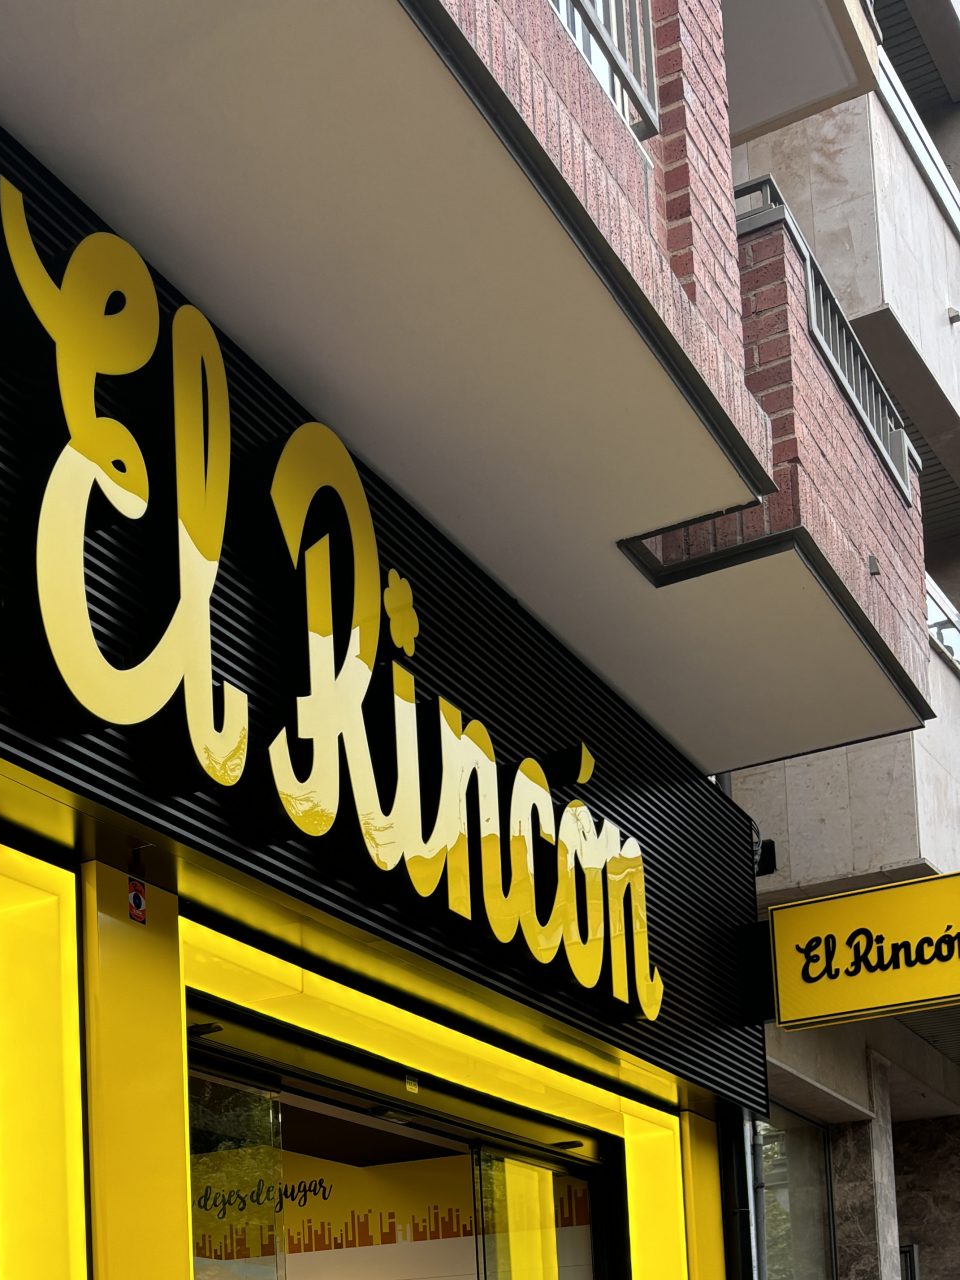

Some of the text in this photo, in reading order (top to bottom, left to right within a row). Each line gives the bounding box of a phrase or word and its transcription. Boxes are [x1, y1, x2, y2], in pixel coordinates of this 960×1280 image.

[0, 174, 665, 1022] El Rincón
[795, 925, 960, 983] El Rincó
[197, 1177, 333, 1219] dejes de jugar
